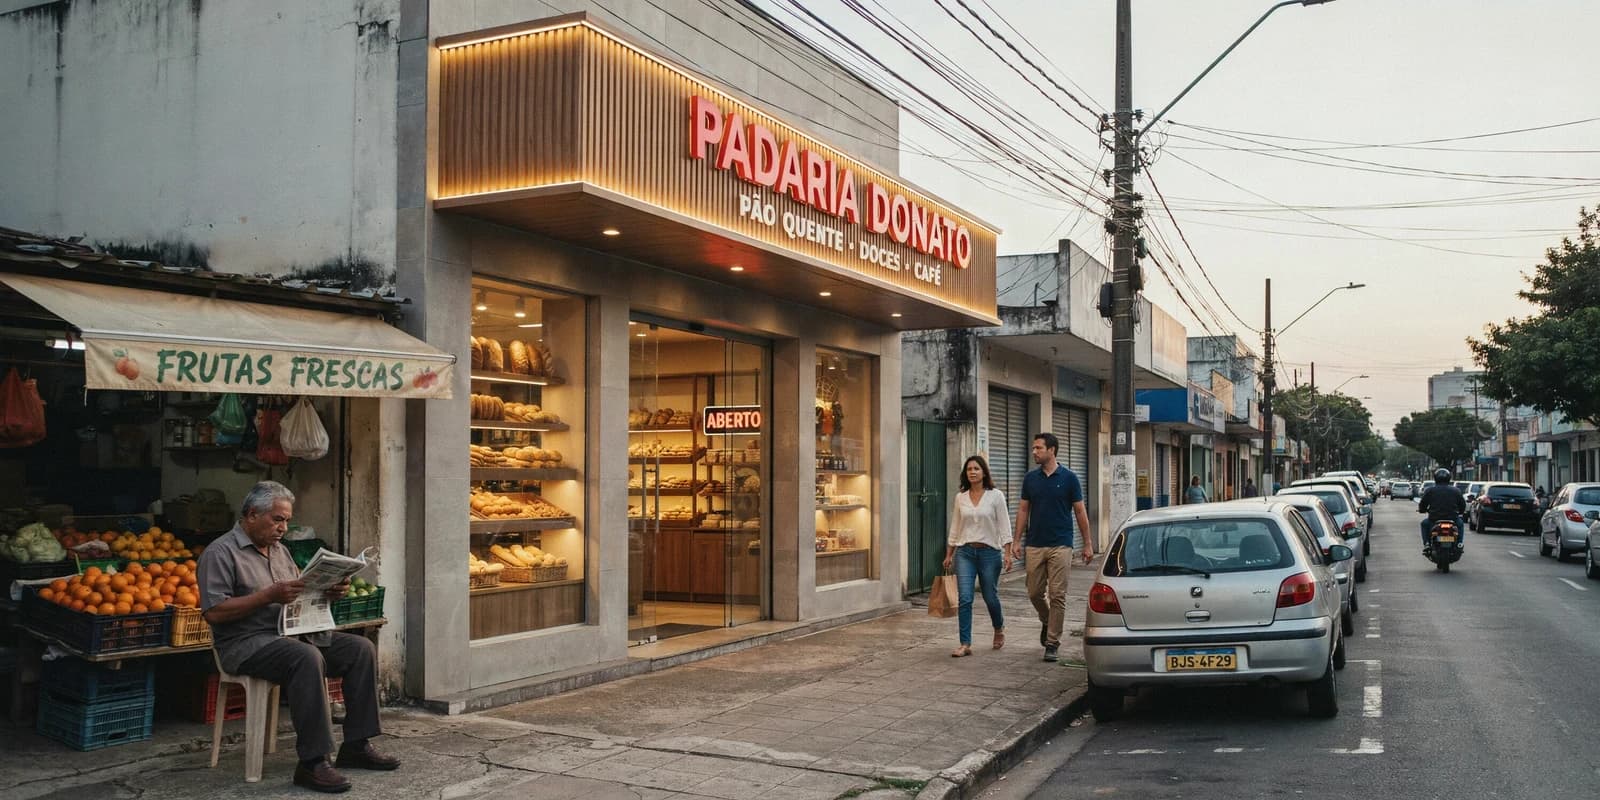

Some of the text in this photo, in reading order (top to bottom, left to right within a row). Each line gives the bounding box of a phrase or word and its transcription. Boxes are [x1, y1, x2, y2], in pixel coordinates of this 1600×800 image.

[689, 95, 971, 269] PADARIA DONATO
[740, 193, 776, 227] PÃO
[783, 212, 844, 253] QUENTE
[859, 242, 901, 271] DOCES
[914, 262, 941, 286] CAFÉ
[157, 348, 404, 391] FRUTAS FRESCAS
[706, 411, 761, 429] ABERTO
